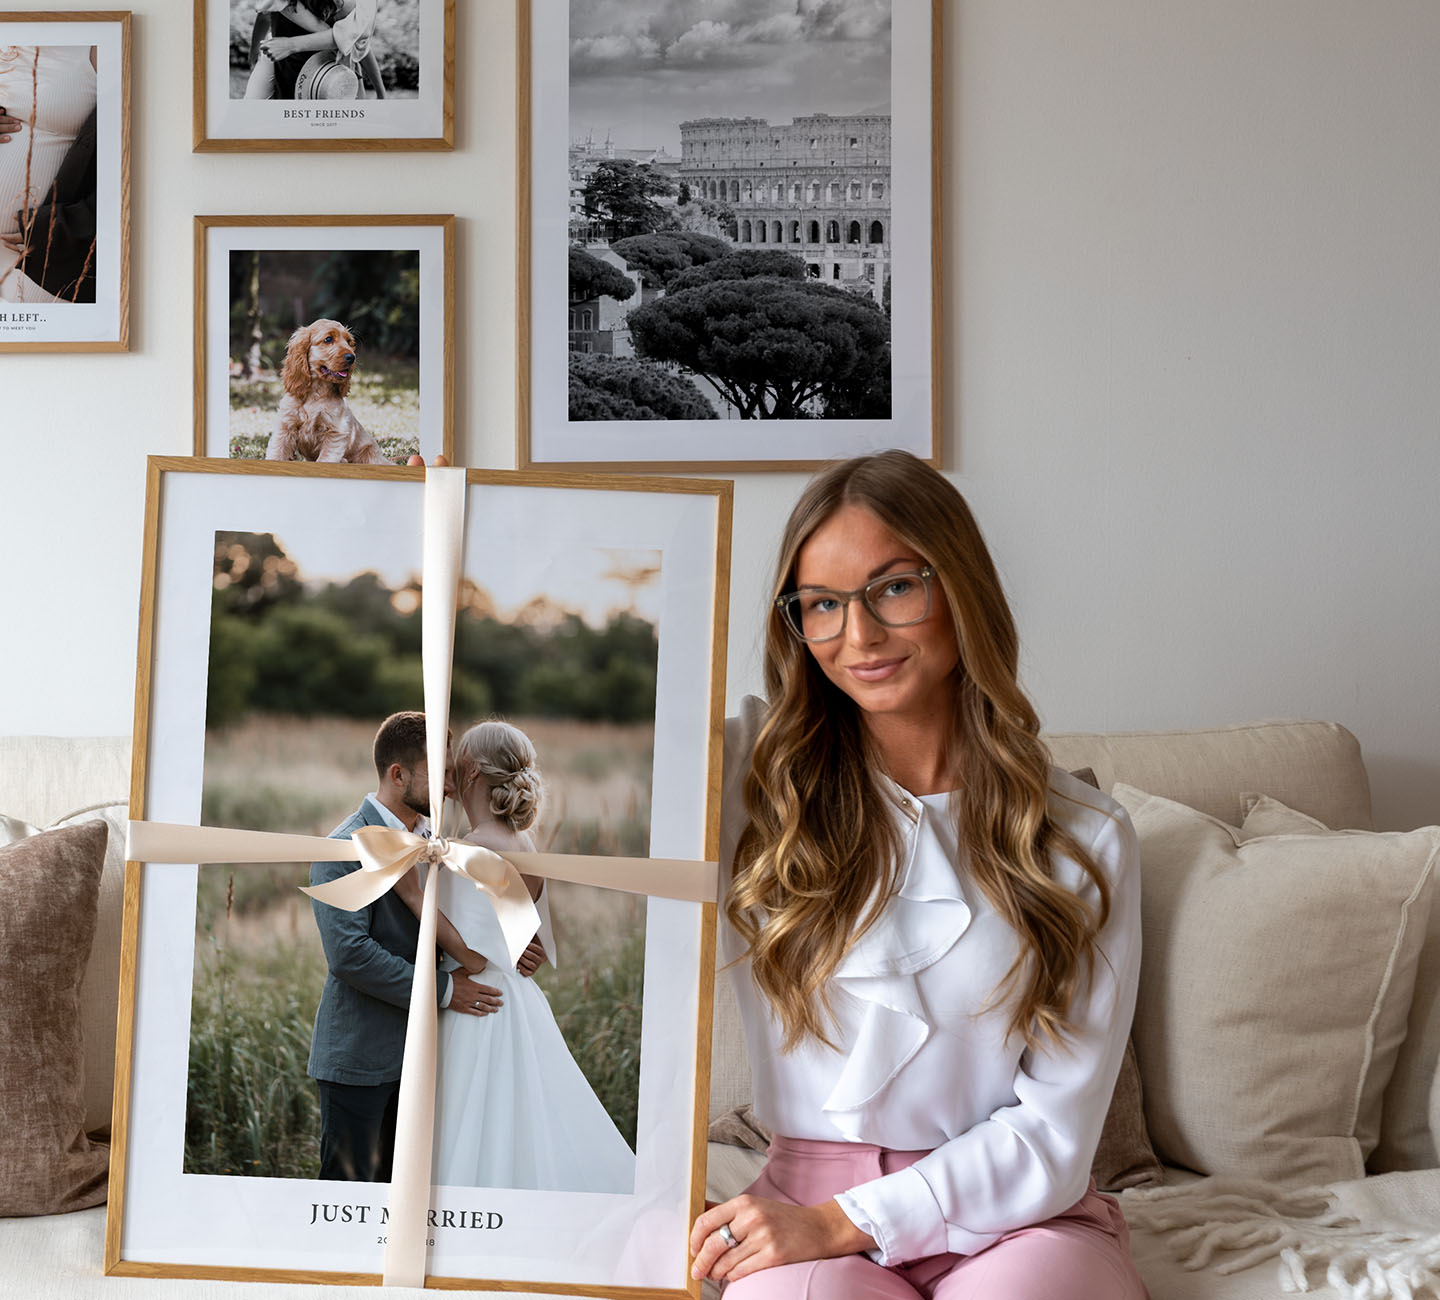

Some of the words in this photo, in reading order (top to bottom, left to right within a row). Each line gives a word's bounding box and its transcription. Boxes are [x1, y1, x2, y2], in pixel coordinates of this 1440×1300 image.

[283, 109, 312, 119] BEST
[315, 109, 365, 119] FRIENDS
[11, 313, 47, 322] LEFT..
[310, 1203, 371, 1225] JUST
[380, 1206, 504, 1230] RRIED
